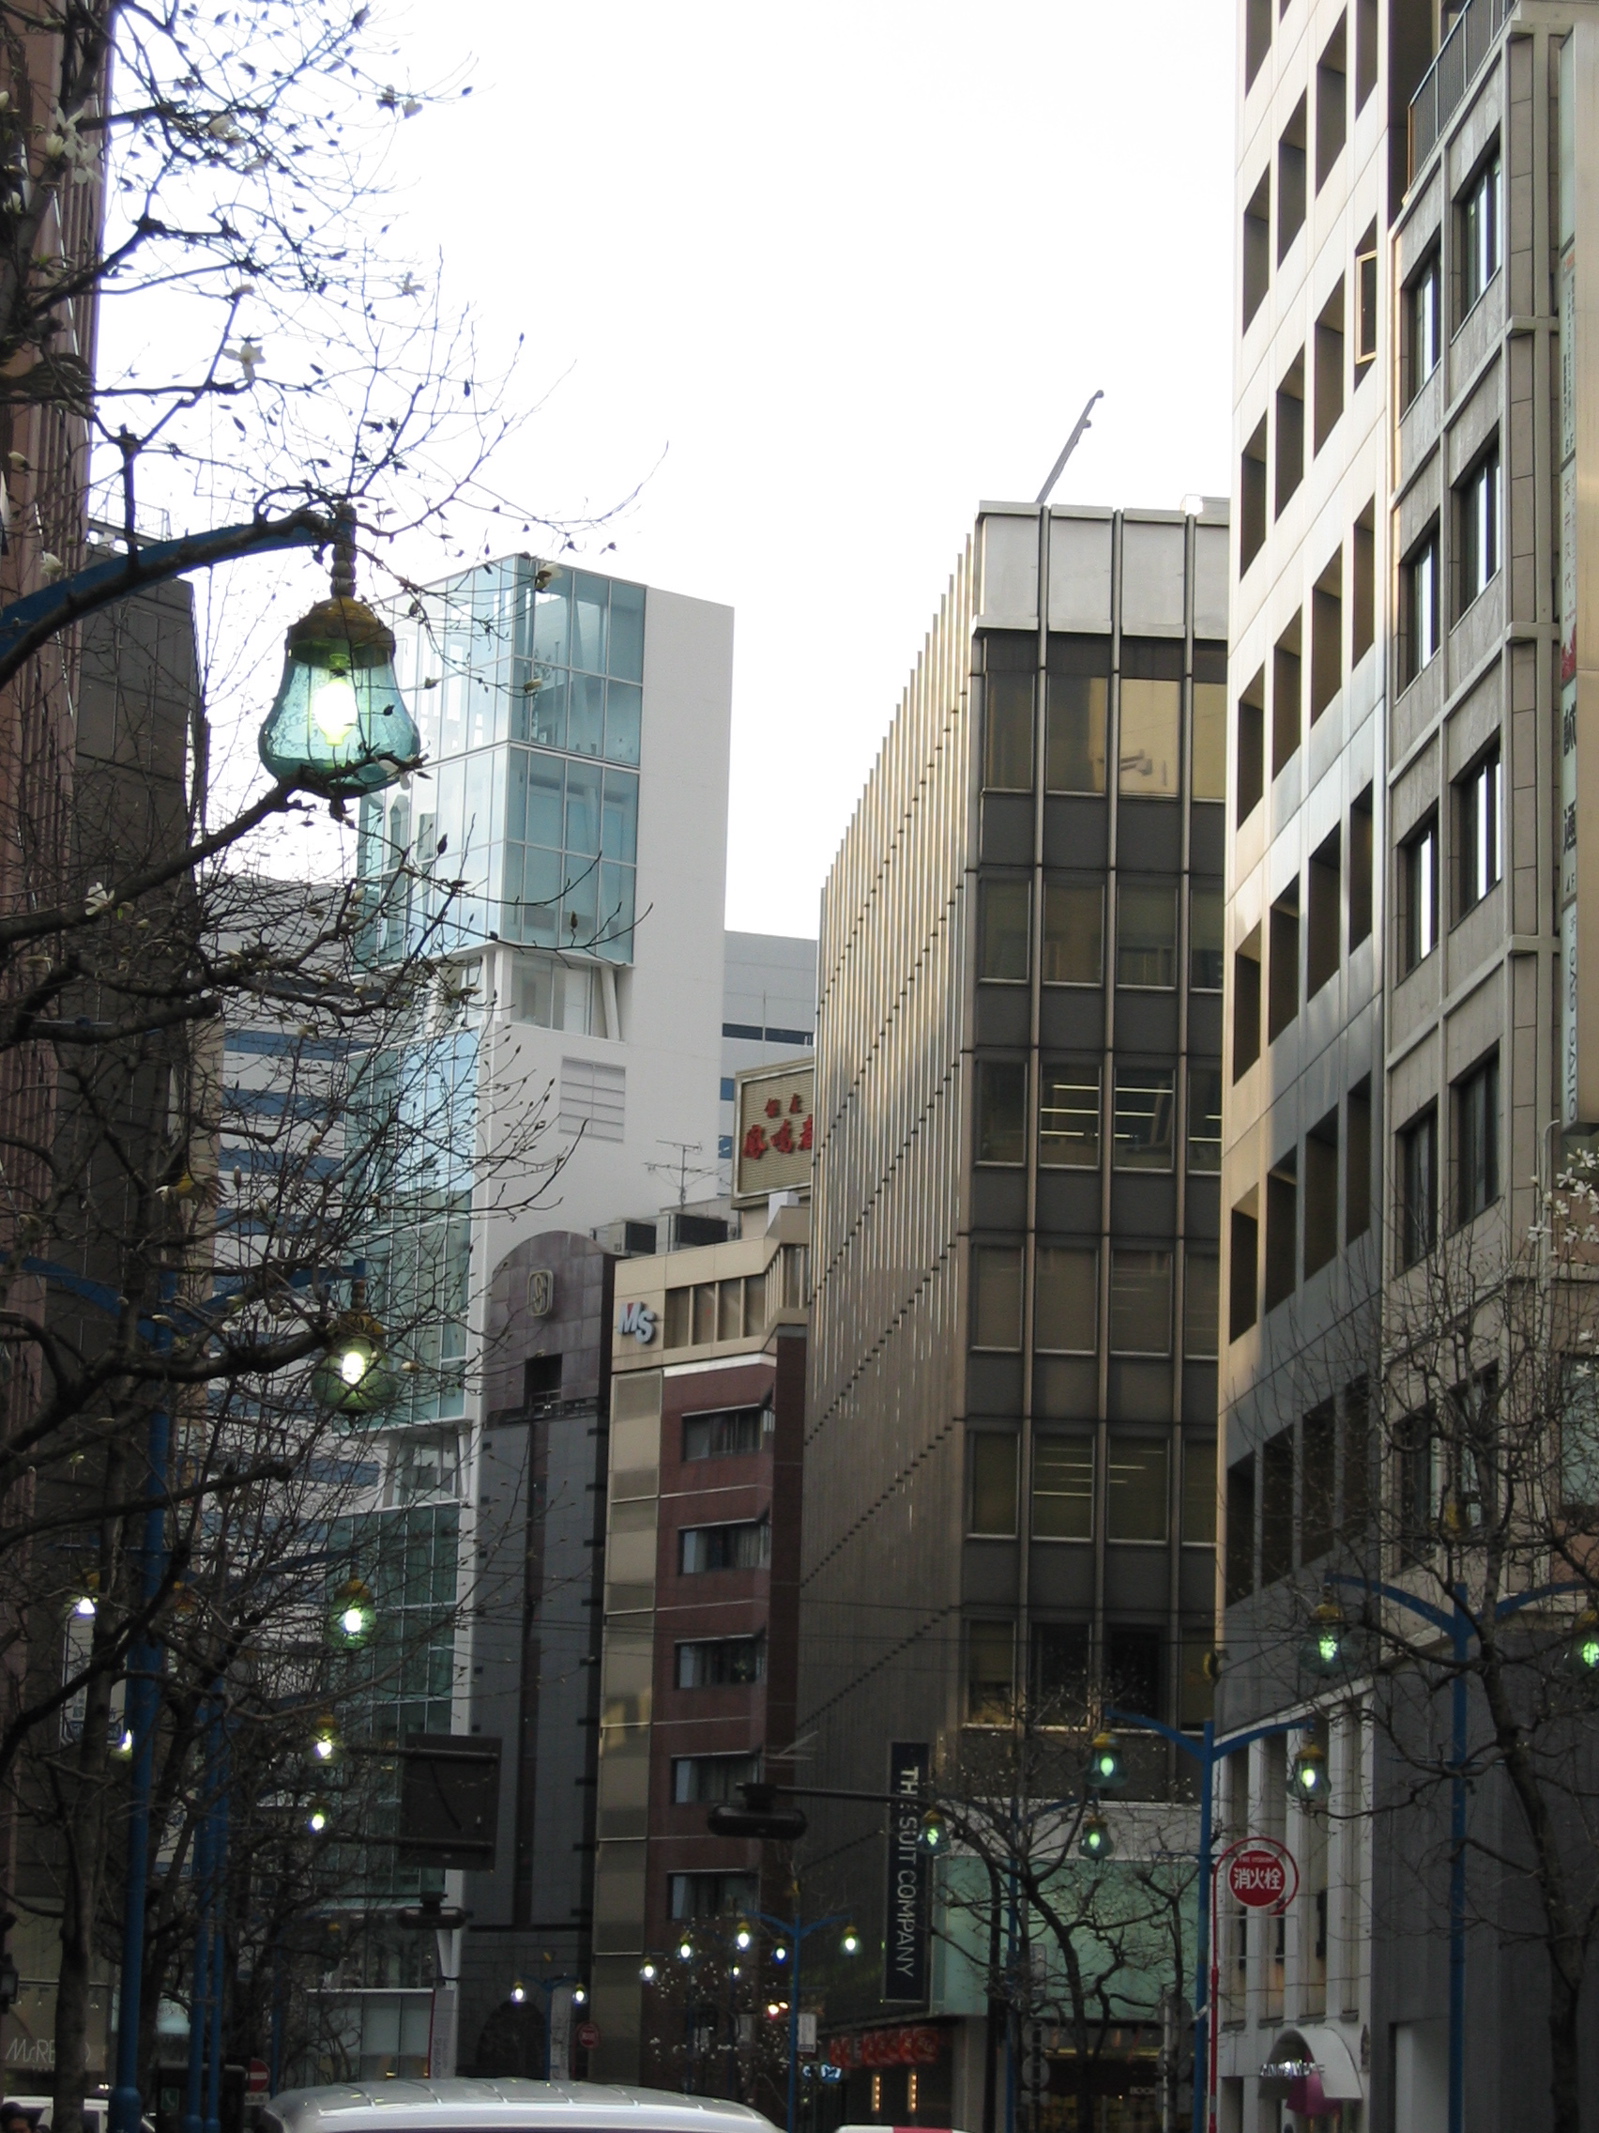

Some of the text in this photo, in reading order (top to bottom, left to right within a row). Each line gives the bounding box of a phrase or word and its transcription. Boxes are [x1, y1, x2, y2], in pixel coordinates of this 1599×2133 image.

[895, 1765, 919, 1978] TH SUIT COMPANY
[1233, 1866, 1282, 1891] 消火栓
